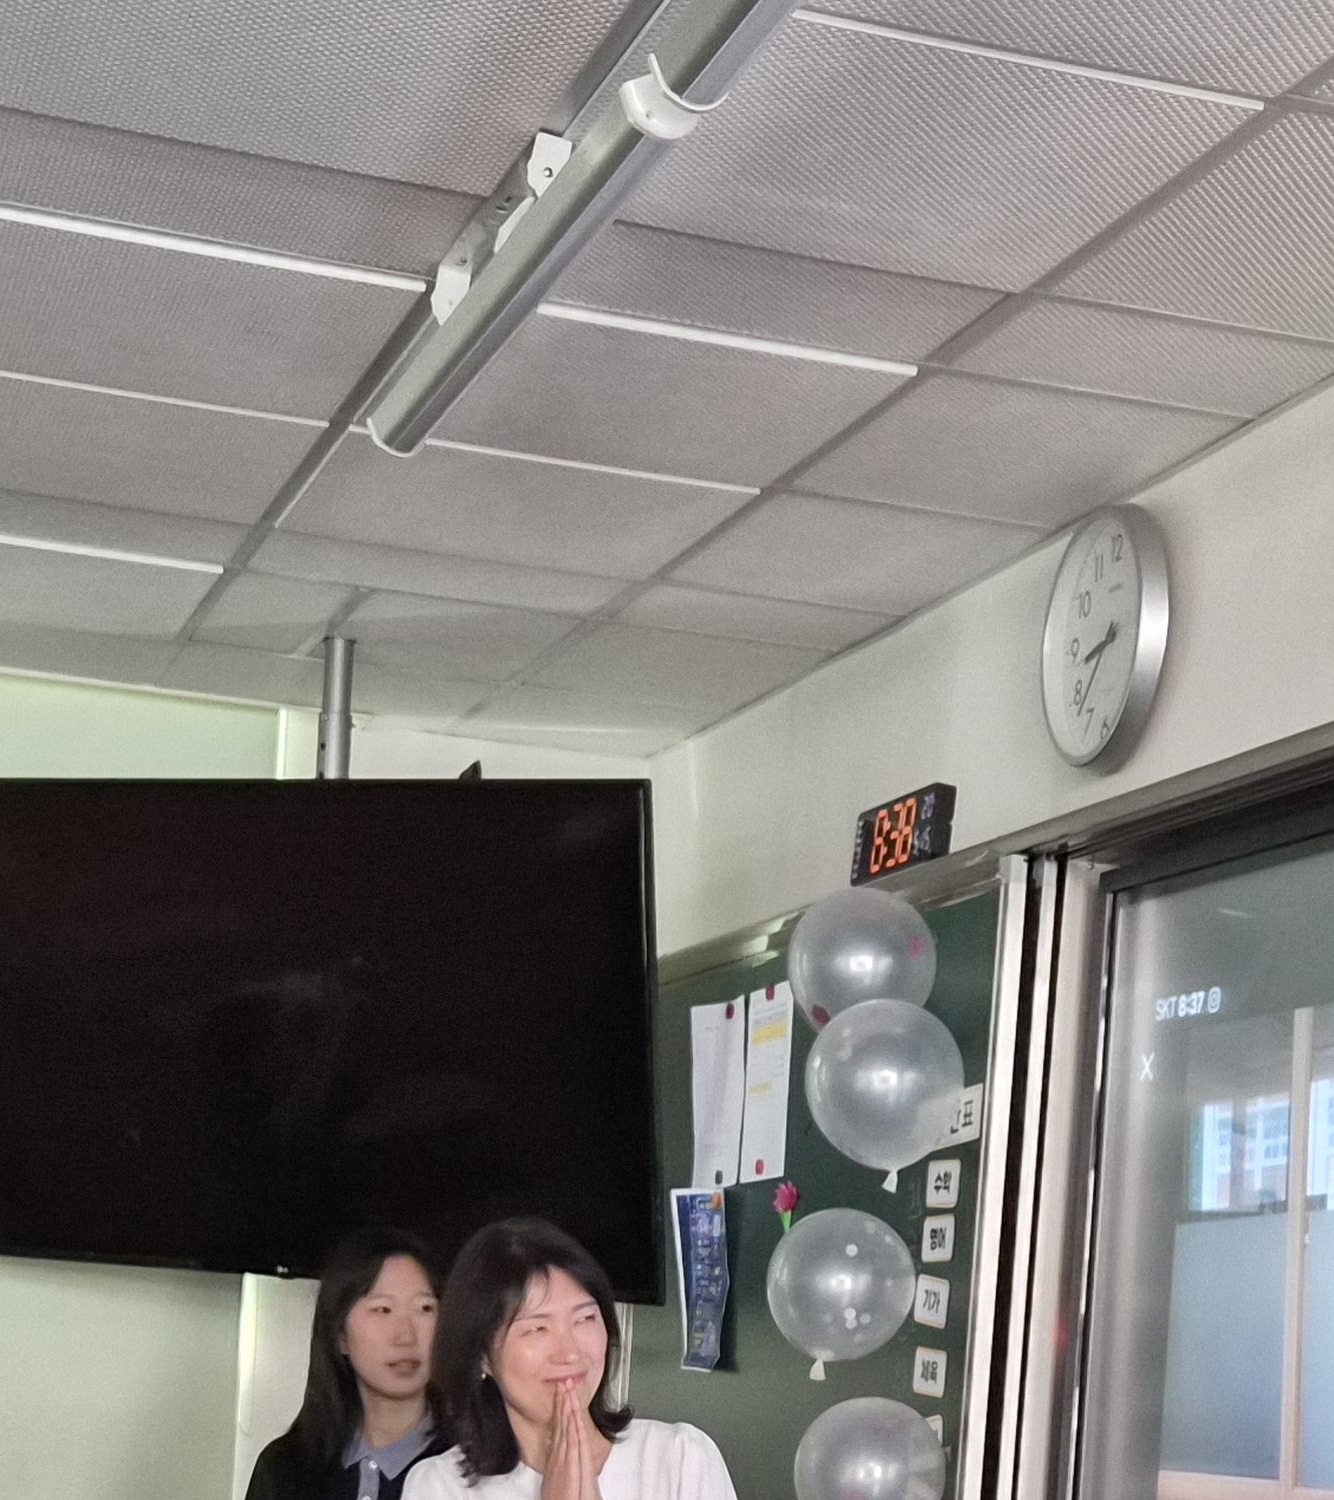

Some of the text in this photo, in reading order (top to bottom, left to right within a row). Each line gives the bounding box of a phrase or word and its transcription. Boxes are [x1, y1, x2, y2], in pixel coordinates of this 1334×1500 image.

[1111, 533, 1123, 563] 12
[1094, 554, 1104, 583] 11
[1078, 590, 1092, 619] 10
[1070, 637, 1080, 664] 9
[1073, 678, 1083, 706] 8
